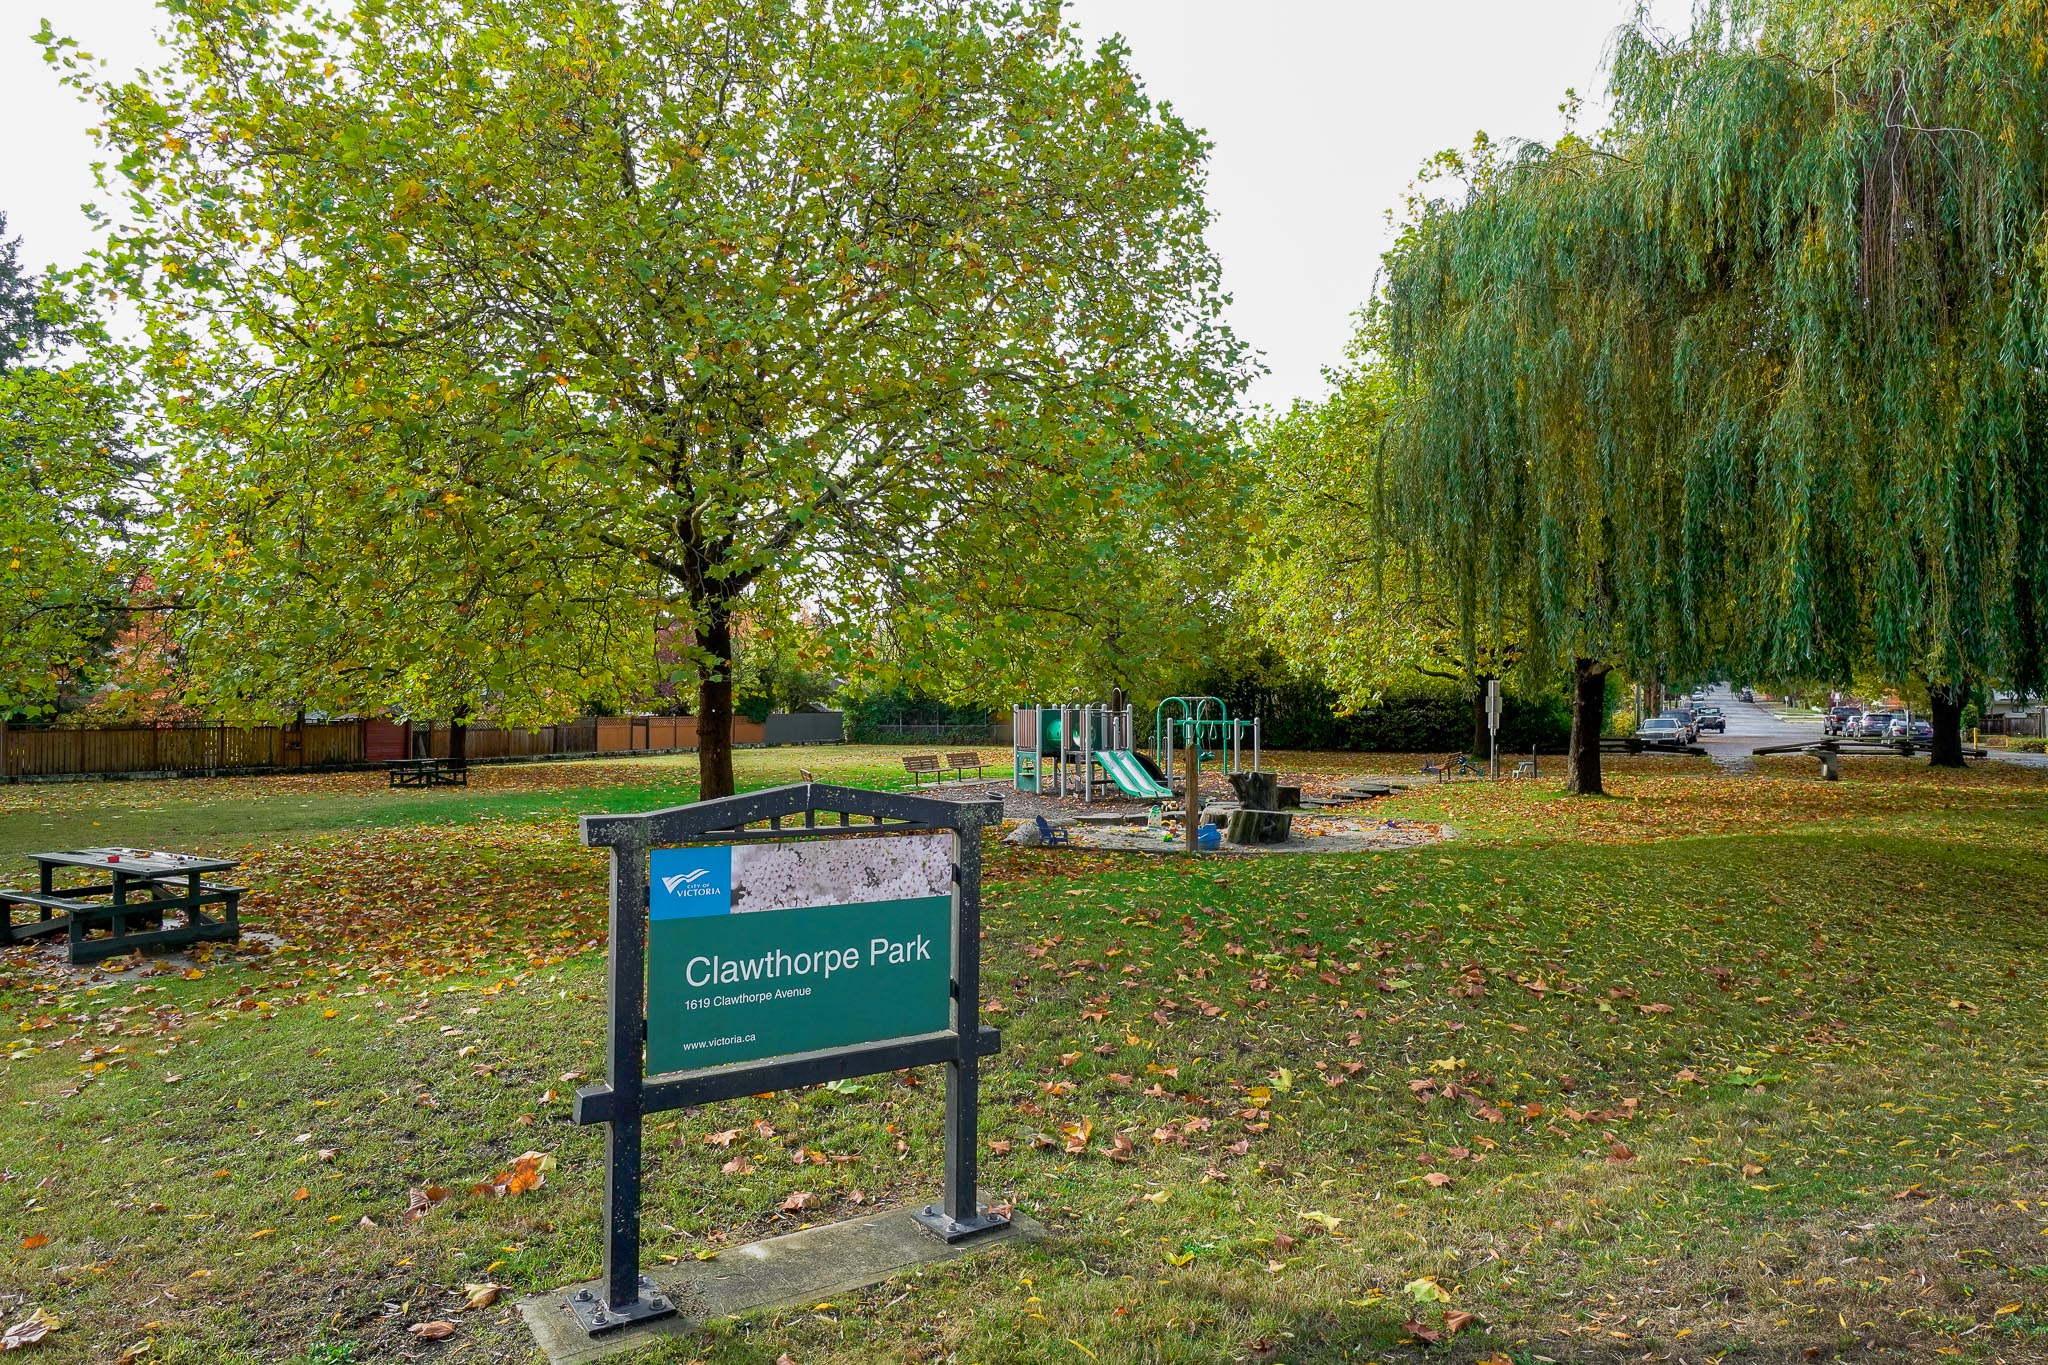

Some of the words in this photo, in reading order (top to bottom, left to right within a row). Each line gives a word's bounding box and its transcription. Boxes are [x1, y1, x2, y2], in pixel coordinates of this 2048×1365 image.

[677, 887, 721, 897] VICTORIA
[685, 947, 859, 987] Clawthorpe
[870, 934, 931, 966] Park
[685, 998, 710, 1010] 1619
[713, 991, 772, 1008] Clawthorpe
[774, 986, 811, 999] Avenue
[683, 1033, 756, 1051] www.victoria.ca
